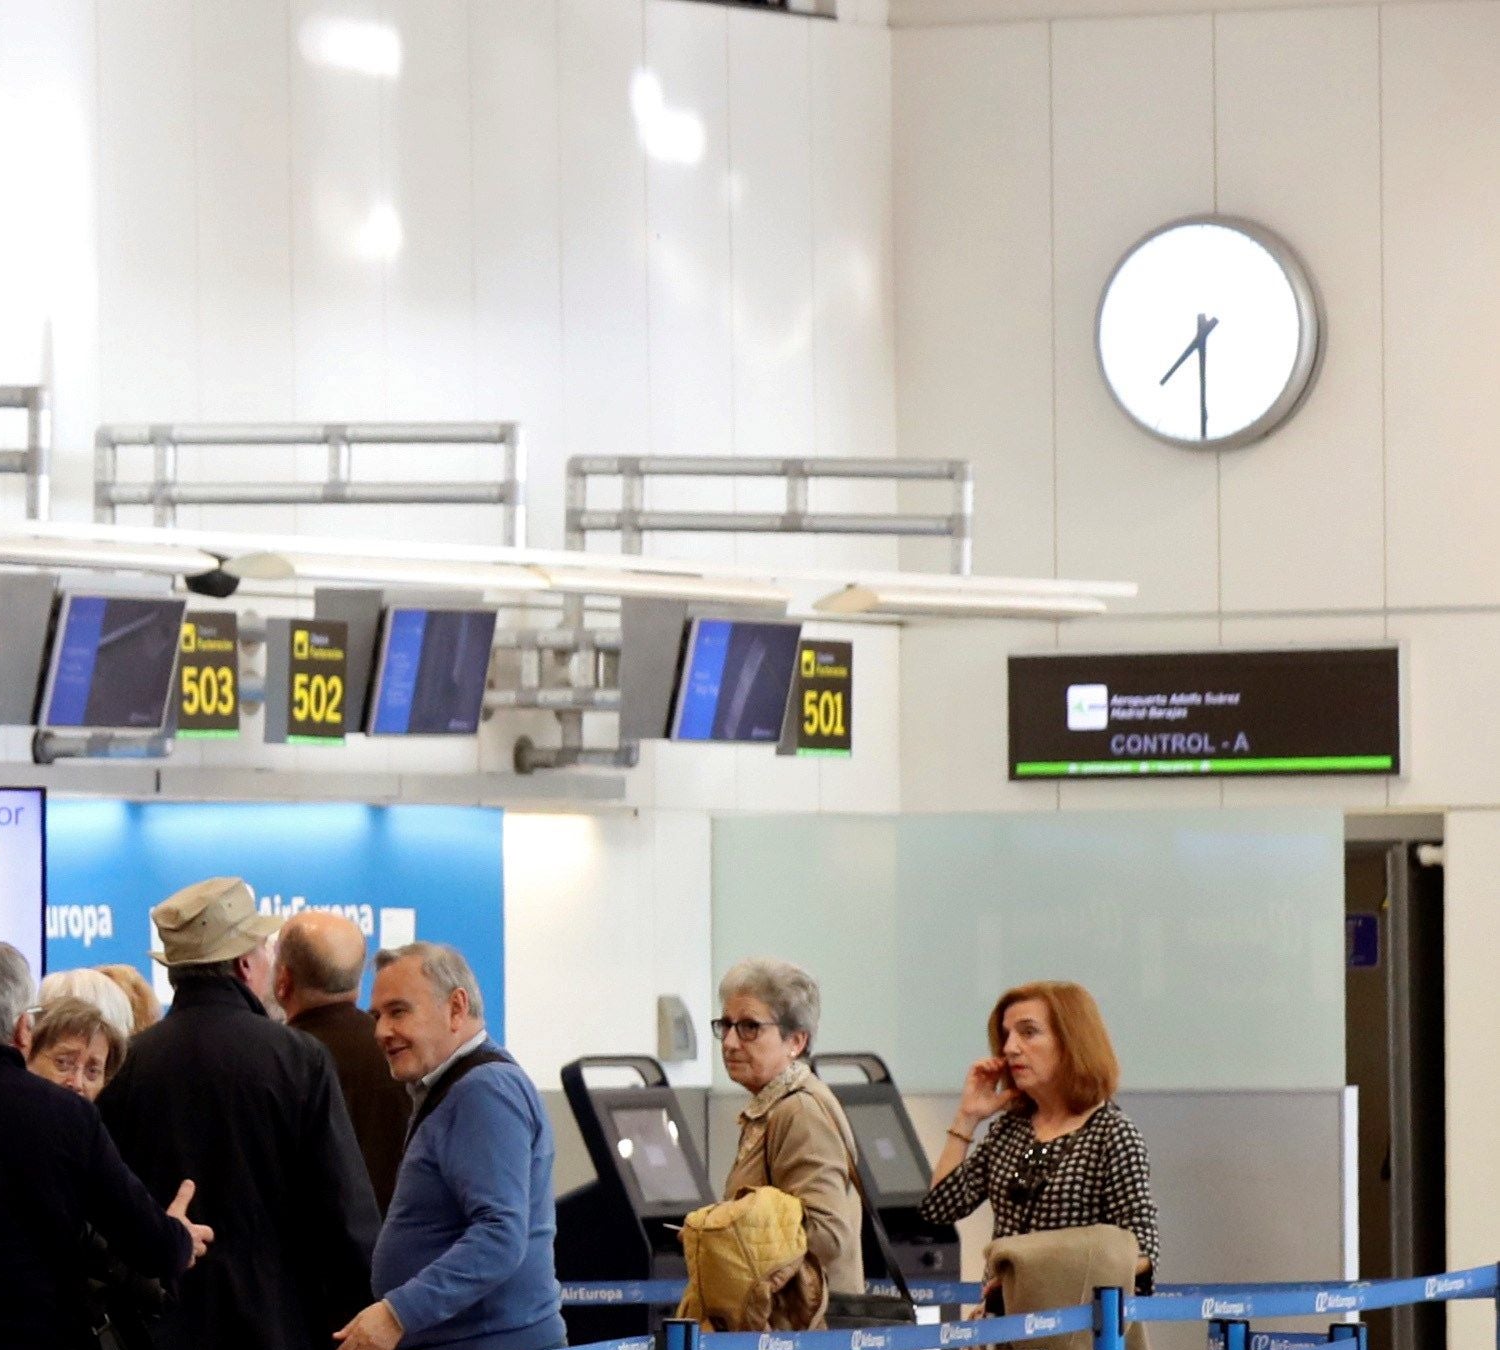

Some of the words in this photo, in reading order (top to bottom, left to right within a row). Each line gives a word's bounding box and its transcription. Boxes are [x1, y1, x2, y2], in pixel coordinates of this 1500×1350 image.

[182, 666, 235, 716] 503
[292, 673, 343, 724] 502
[803, 689, 845, 736] 501
[1110, 732, 1215, 755] CONTROL
[1233, 731, 1249, 752] A
[561, 1285, 624, 1302] AirEuropa
